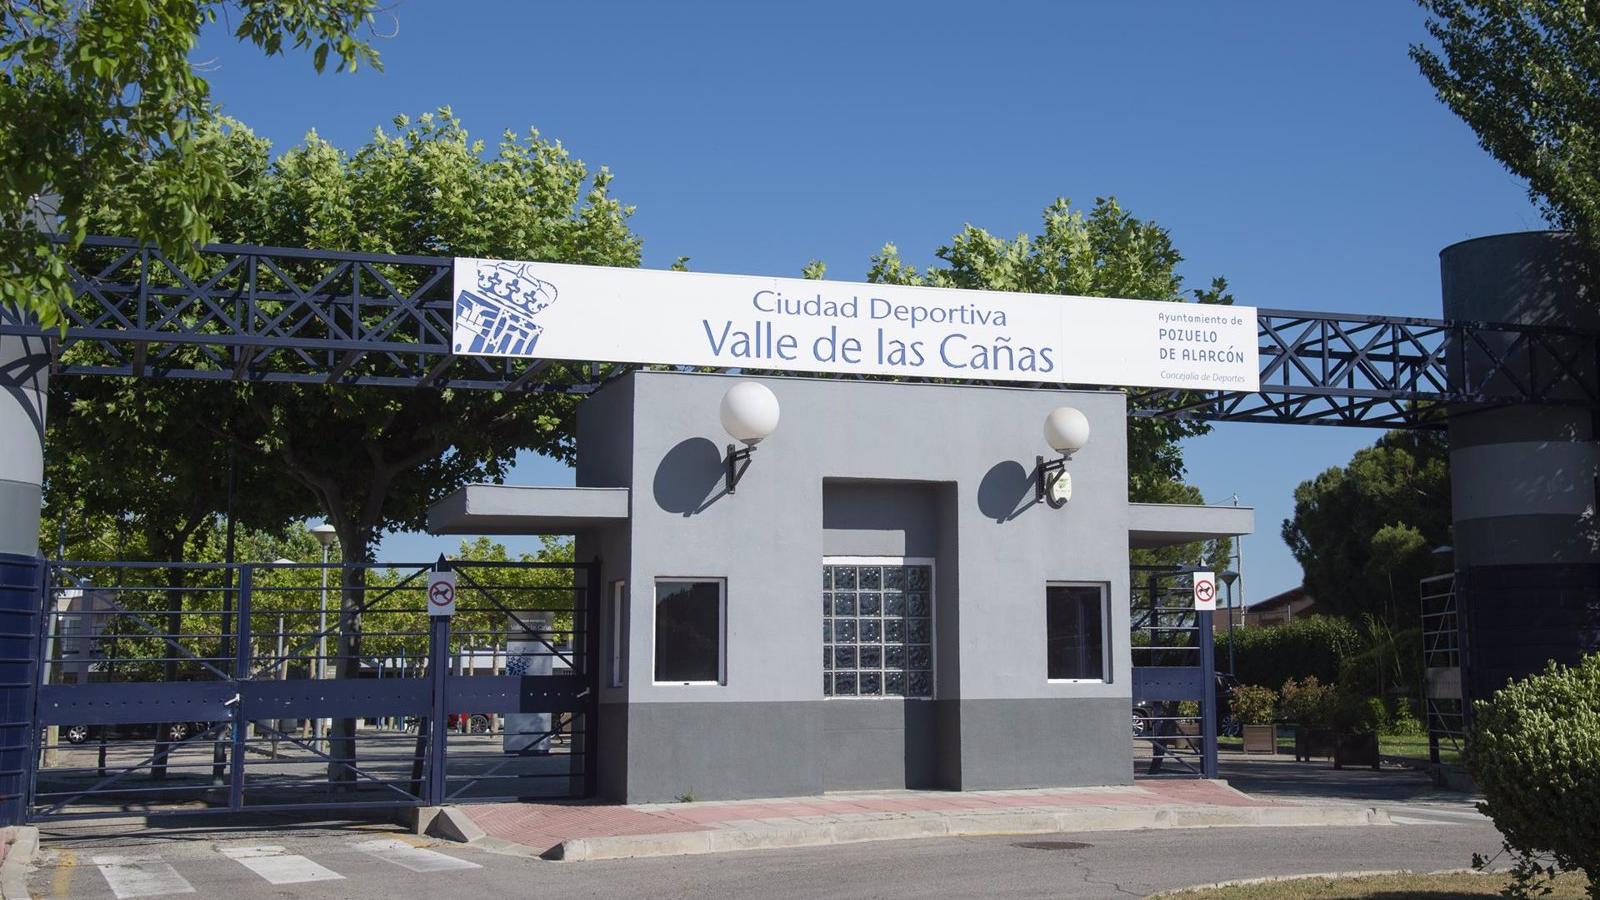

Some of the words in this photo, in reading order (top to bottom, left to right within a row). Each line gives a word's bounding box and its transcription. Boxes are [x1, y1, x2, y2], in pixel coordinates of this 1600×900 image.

[753, 290, 858, 319] Ciudad
[870, 298, 1007, 329] Deportiva
[1158, 312, 1228, 324] Ayuntamiento
[1230, 316, 1243, 325] de
[1159, 328, 1217, 343] POZUELO
[703, 320, 798, 361] Valle
[813, 326, 862, 364] de
[877, 328, 925, 367] las
[940, 334, 1054, 374] Cañas
[1160, 347, 1176, 360] DE
[1182, 345, 1244, 363] ALARCÓN
[1201, 372, 1210, 380] de
[1212, 374, 1246, 383] Deportes
